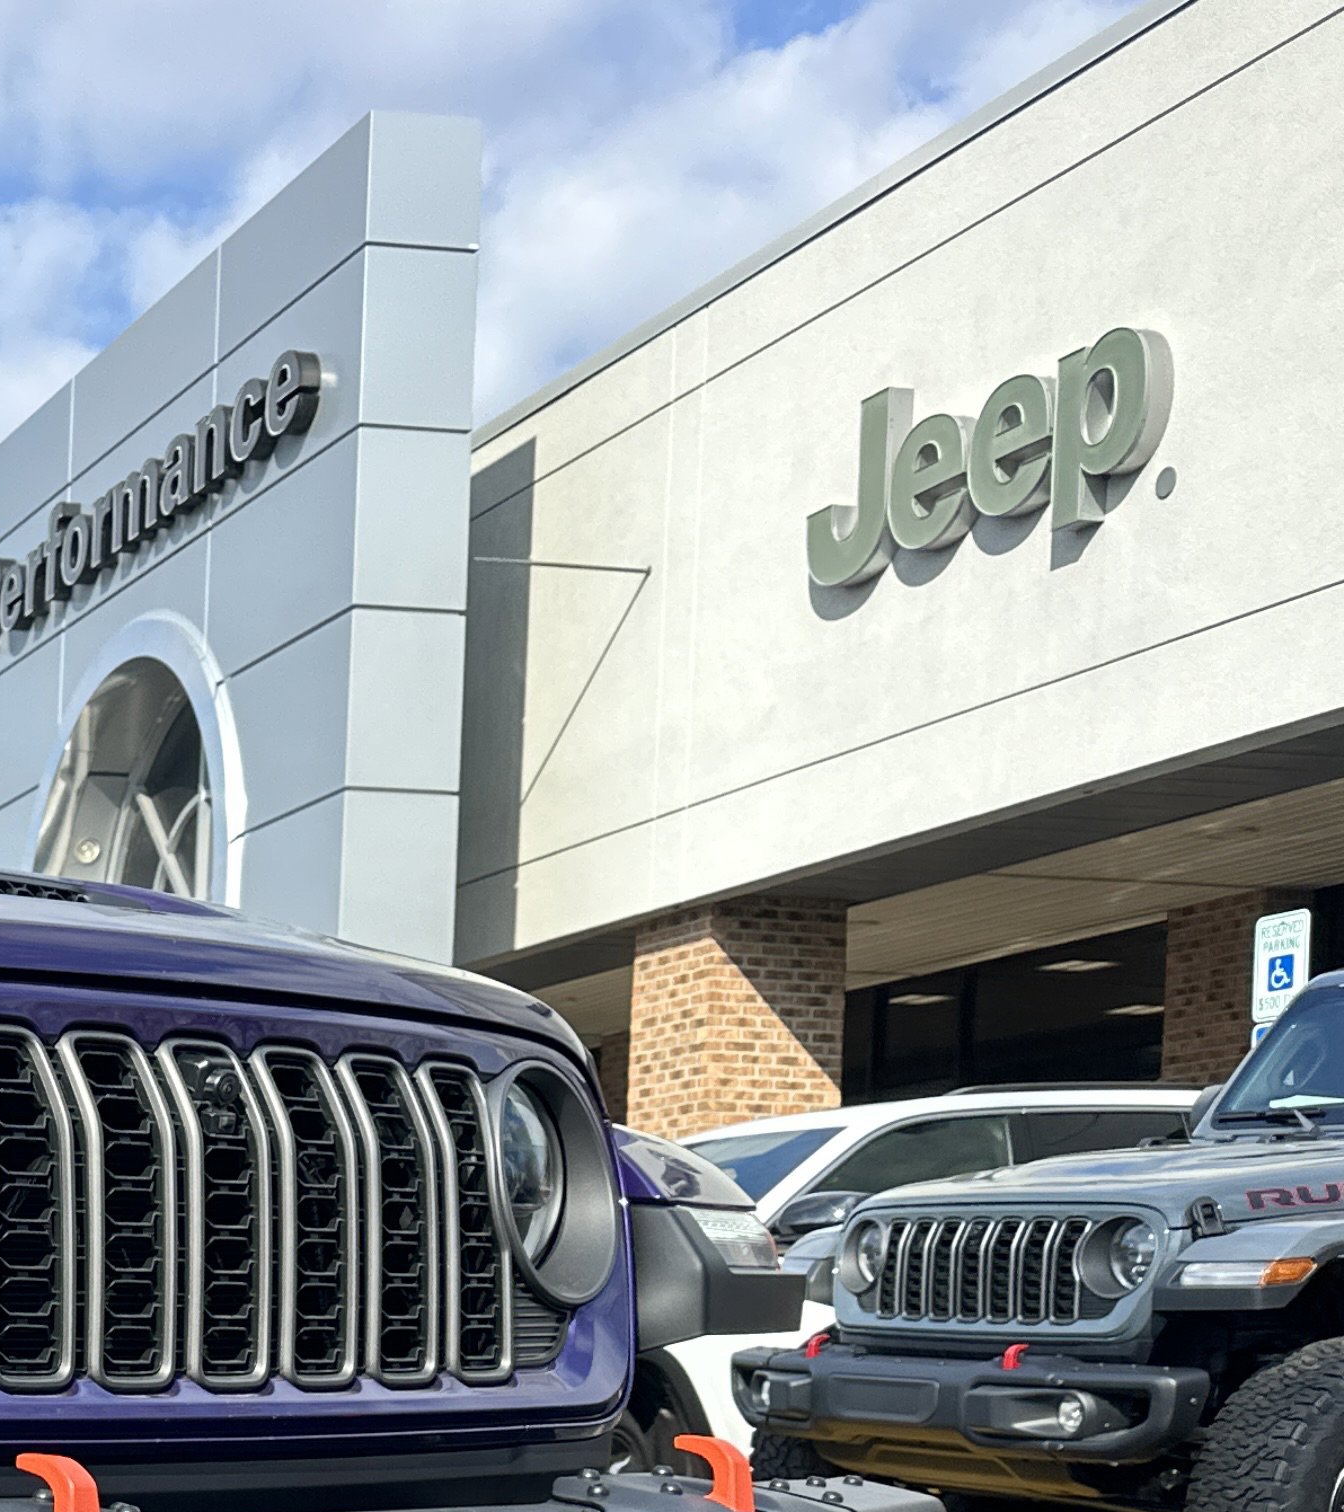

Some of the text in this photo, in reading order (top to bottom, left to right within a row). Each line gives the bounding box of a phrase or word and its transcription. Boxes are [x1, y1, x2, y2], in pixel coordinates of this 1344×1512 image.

[806, 326, 1175, 588] Jeep
[1261, 919, 1304, 939] RESERVED
[1263, 935, 1301, 953] PARKING
